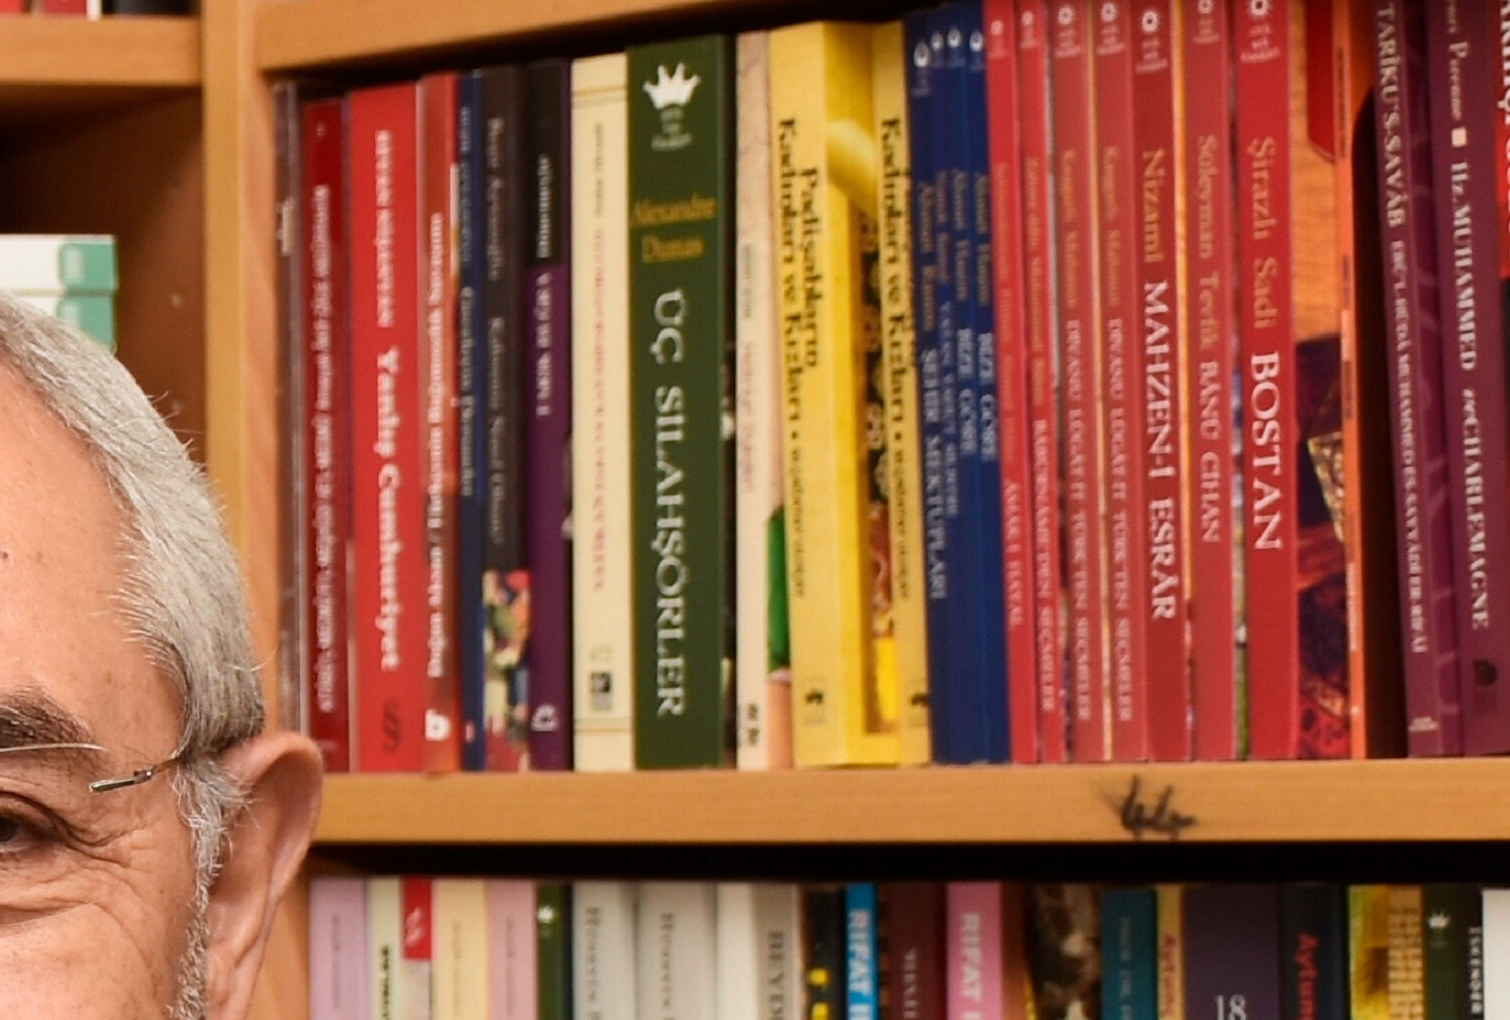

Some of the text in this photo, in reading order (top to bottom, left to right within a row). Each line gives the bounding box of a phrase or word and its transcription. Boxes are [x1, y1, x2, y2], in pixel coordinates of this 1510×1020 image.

[1195, 134, 1220, 260] Süleyman
[374, 347, 401, 670] Yanlış Cumhuriyet
[650, 288, 687, 717] ÜÇ SİLAHŞÖRLER
[1251, 351, 1283, 551] BOSTAN
[847, 909, 871, 996] RIFAT
[960, 912, 983, 1001] RIFAT
